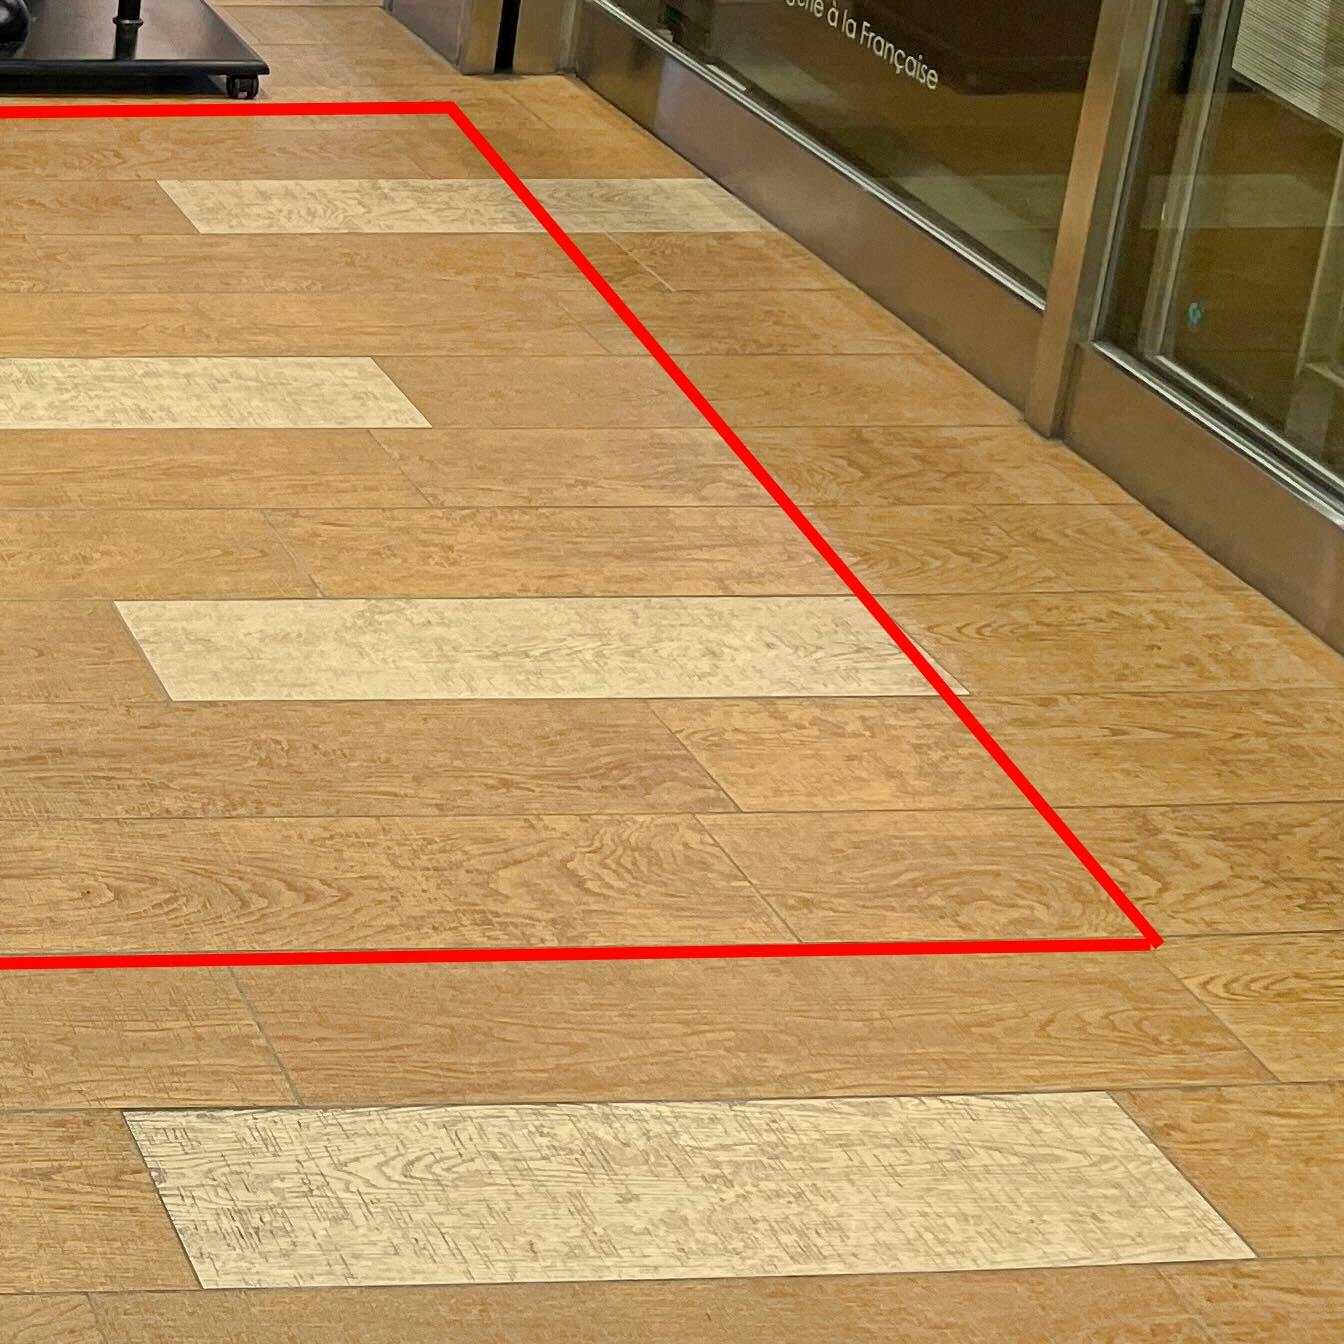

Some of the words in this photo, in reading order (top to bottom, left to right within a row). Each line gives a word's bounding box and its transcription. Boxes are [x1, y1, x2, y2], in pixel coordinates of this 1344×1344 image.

[827, 0, 840, 28] à
[841, 9, 857, 40] la
[860, 20, 939, 90] Française
